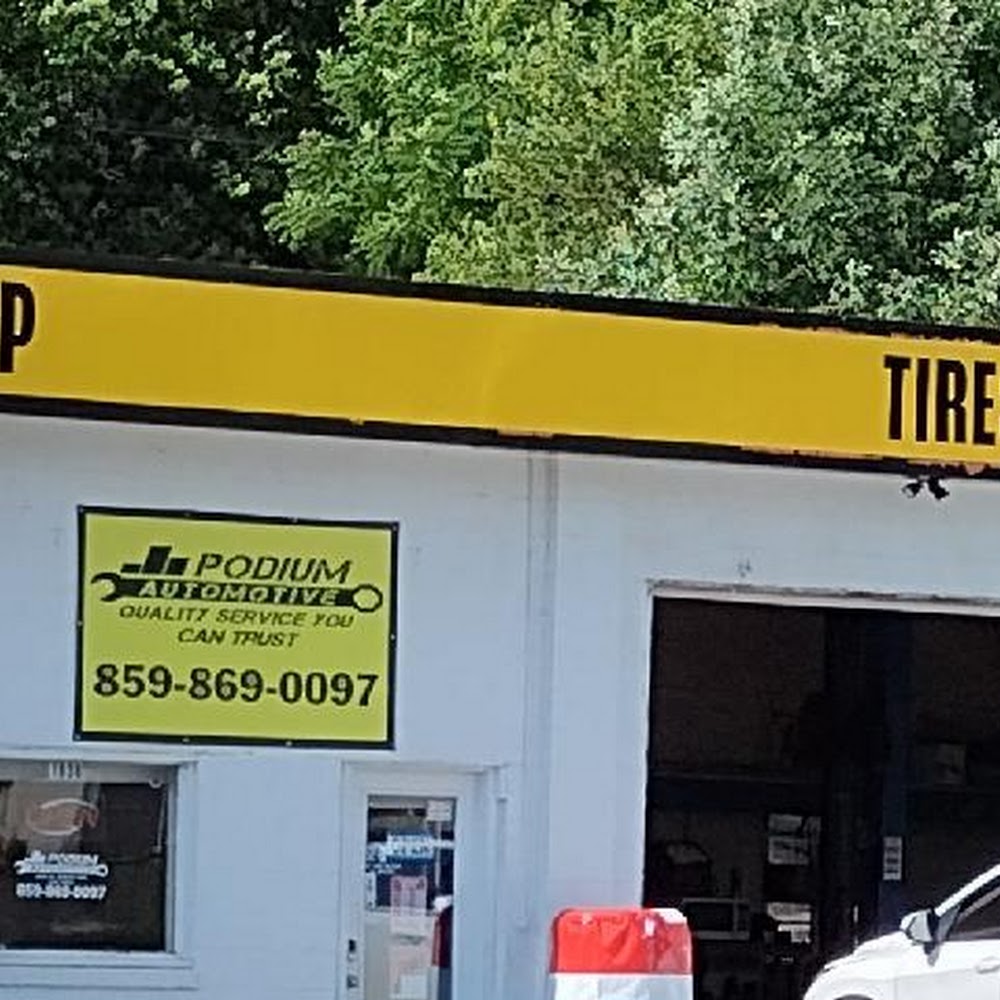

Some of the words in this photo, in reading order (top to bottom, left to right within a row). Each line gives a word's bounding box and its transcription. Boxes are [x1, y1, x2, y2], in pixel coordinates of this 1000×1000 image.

[195, 553, 352, 584] PODIUM
[138, 581, 338, 605] AUTOMOTIVE
[119, 605, 209, 623] QUALITY
[216, 608, 307, 627] SERVICE
[314, 613, 354, 628] YOU
[177, 628, 225, 646] CAN
[231, 630, 299, 648] TRUST
[93, 663, 379, 706] 859-869-0097
